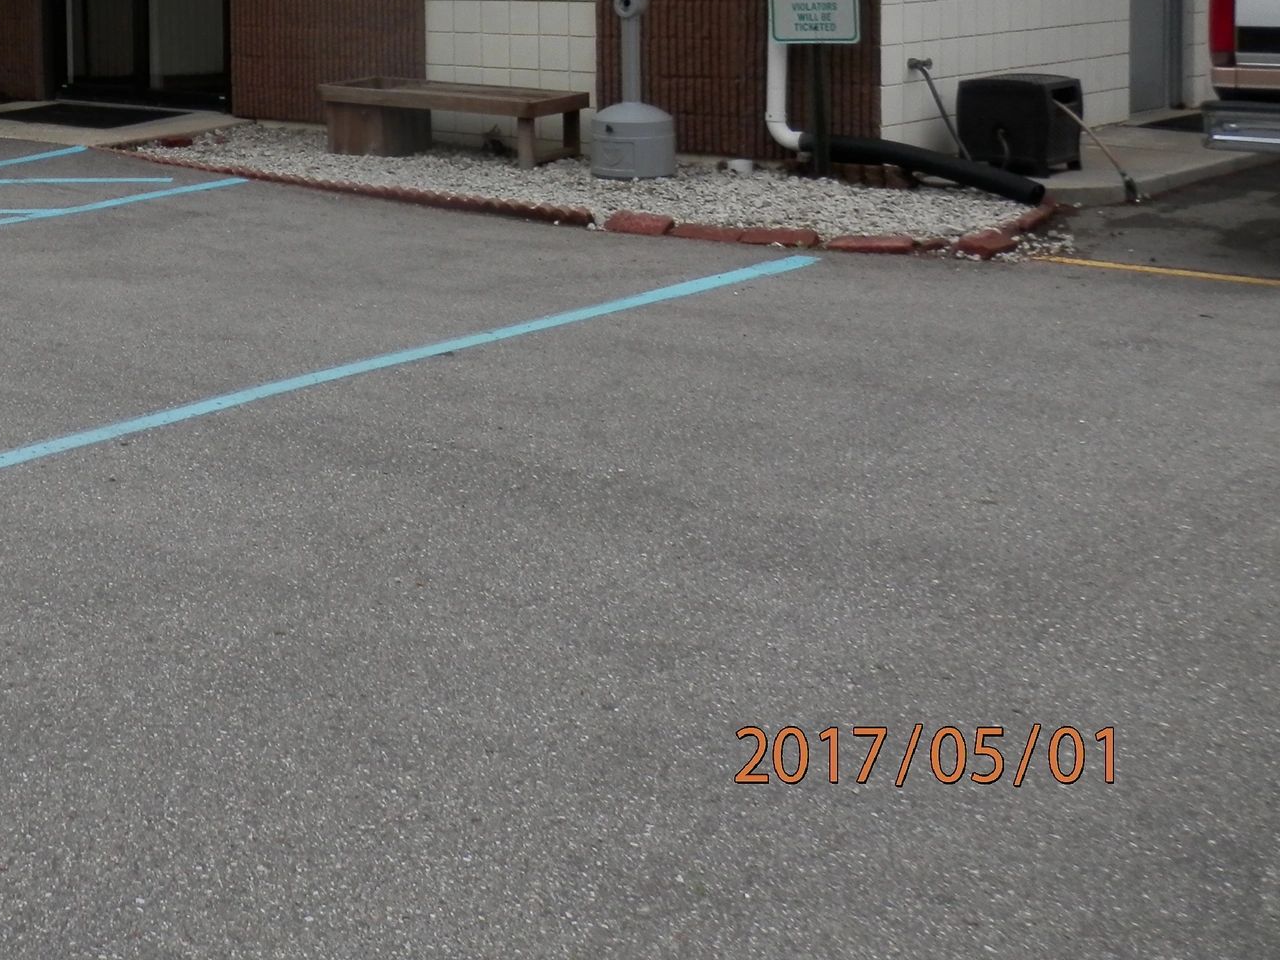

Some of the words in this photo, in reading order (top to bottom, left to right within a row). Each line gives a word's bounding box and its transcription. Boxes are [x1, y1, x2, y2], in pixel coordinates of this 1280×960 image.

[791, 2, 837, 11] VIOLATORS
[797, 13, 818, 21] WILL
[821, 12, 832, 21] BE
[795, 23, 836, 31] TICKETED
